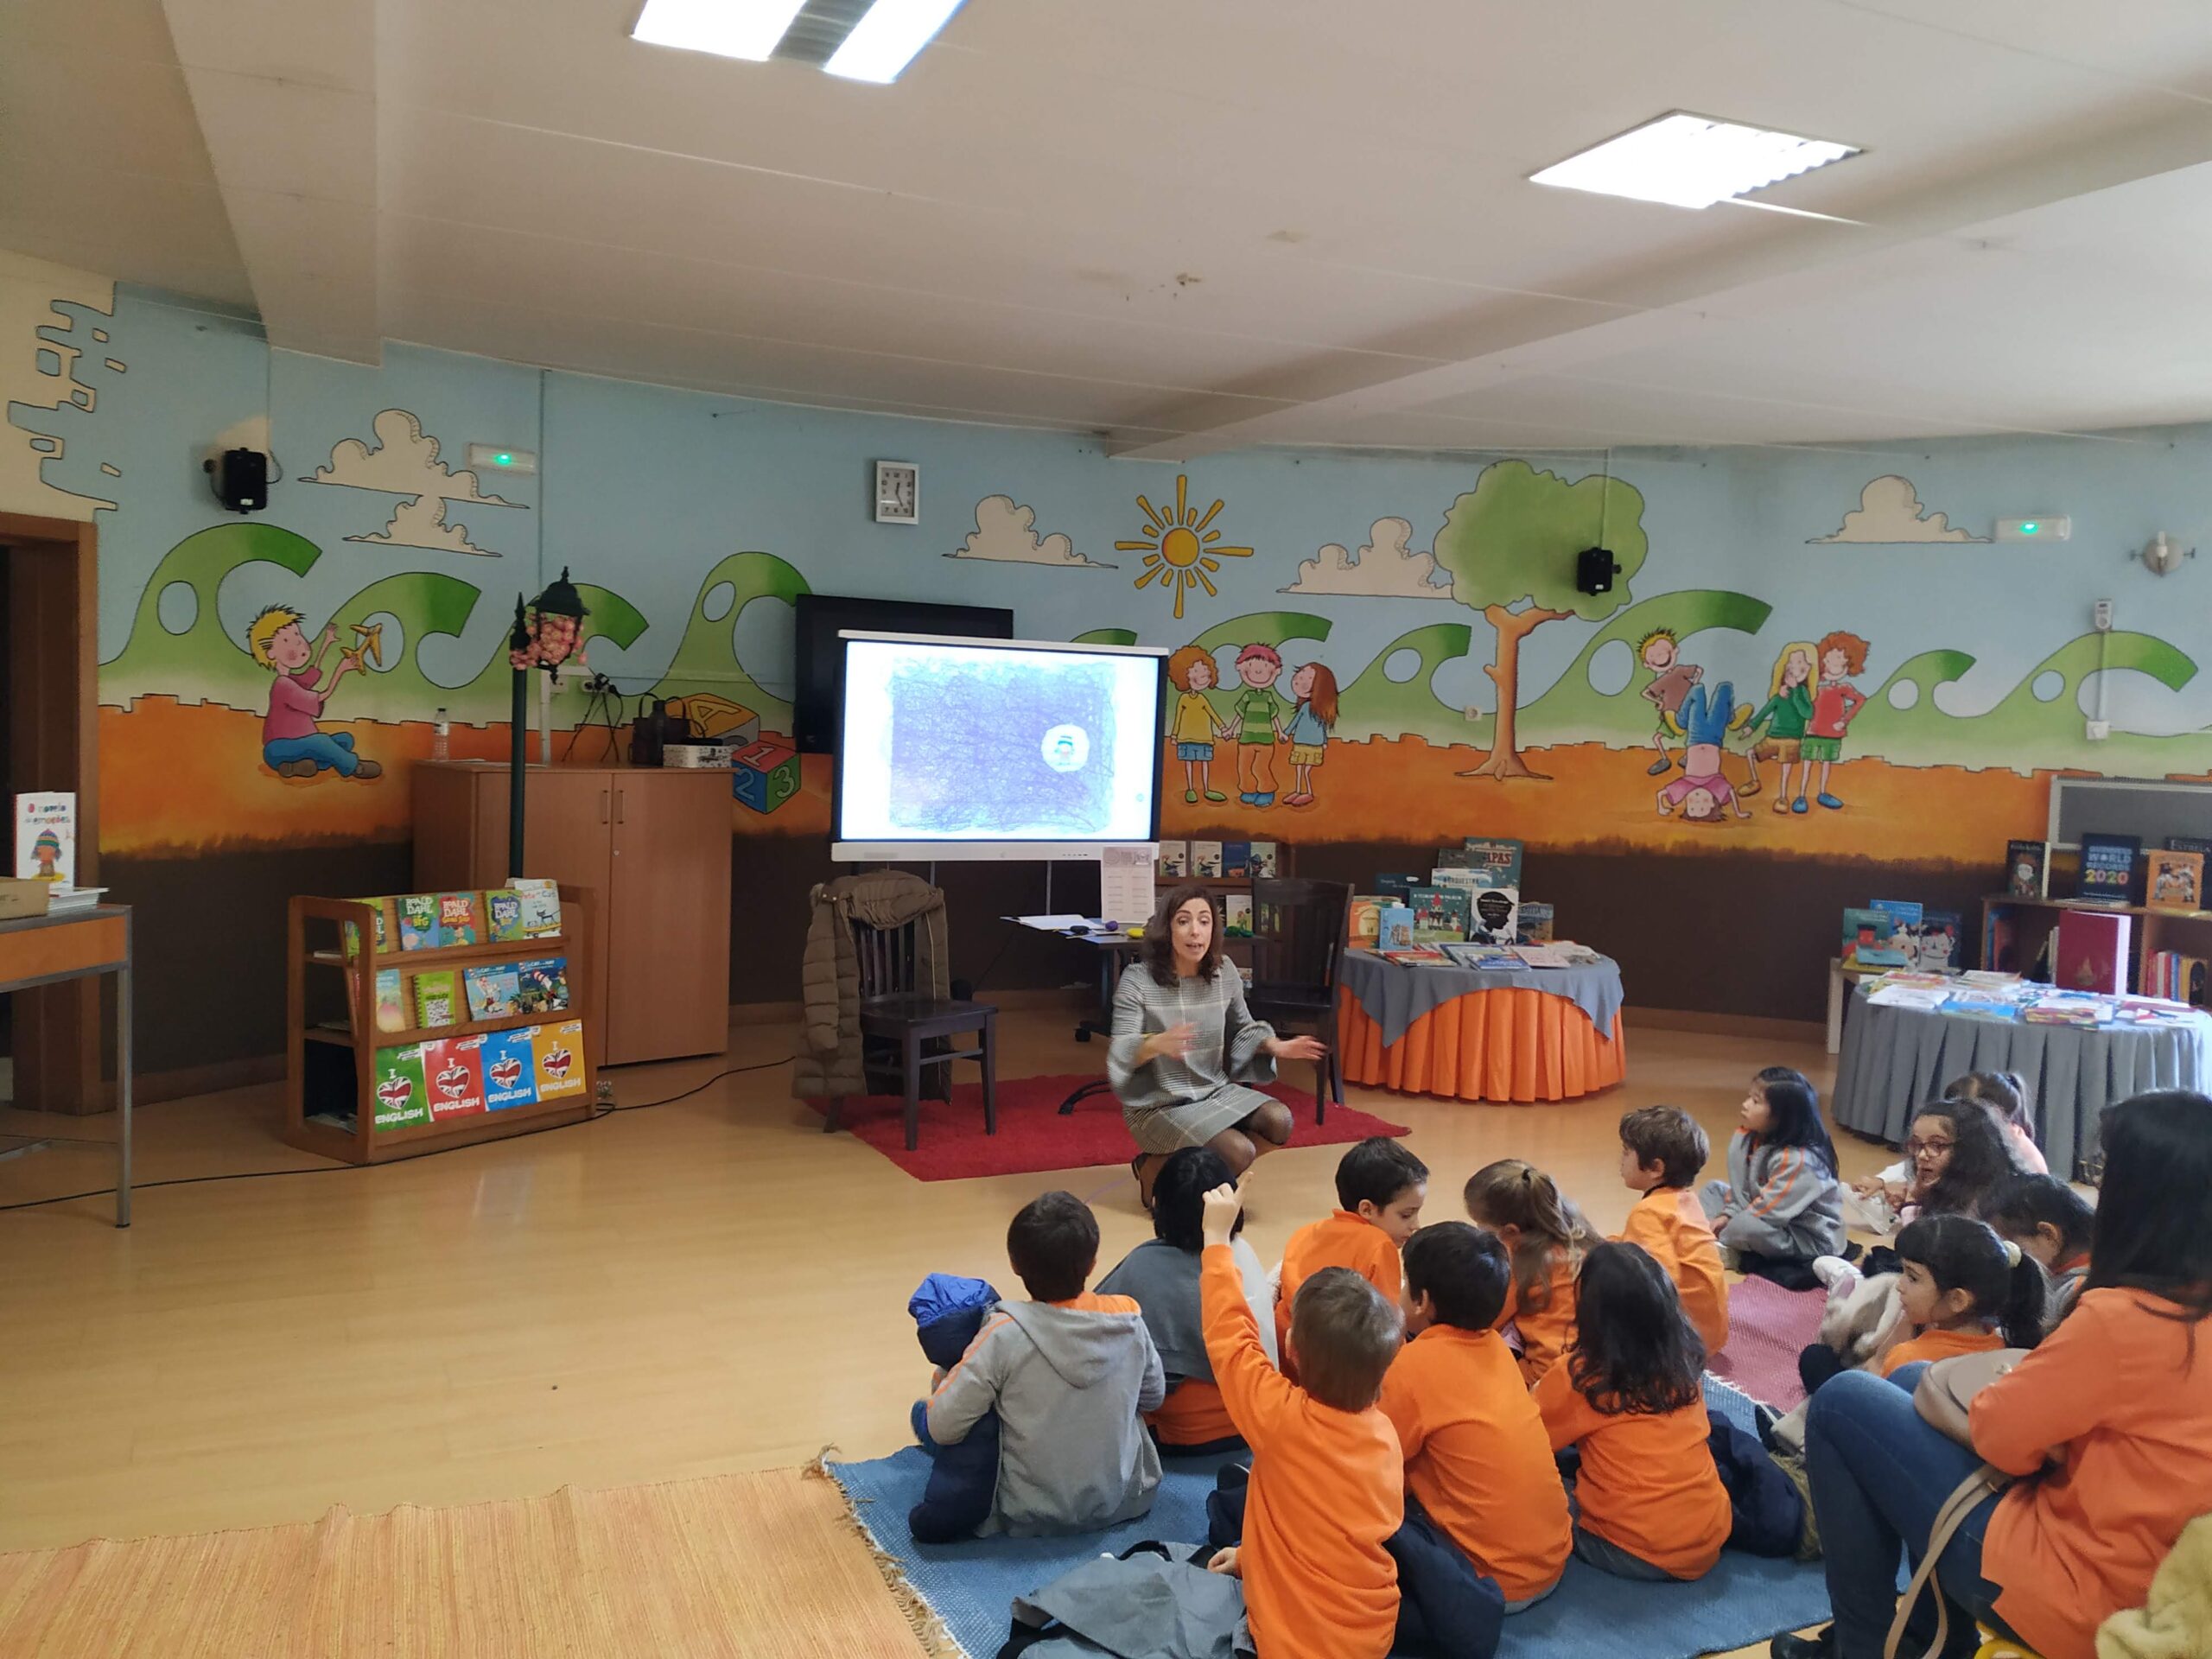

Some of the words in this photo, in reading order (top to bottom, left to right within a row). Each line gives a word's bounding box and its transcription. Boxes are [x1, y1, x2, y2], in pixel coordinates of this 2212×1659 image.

[689, 699, 741, 734] A
[743, 746, 775, 767] 1
[735, 768, 755, 802] 2
[773, 766, 795, 798] 3
[2088, 853, 2132, 863] WORLD
[2084, 869, 2129, 885] 2020
[405, 896, 433, 907] ROALD
[442, 899, 468, 910] ROALD
[493, 900, 518, 910] ROALD
[406, 905, 433, 915] DAHL
[443, 907, 469, 917] DAHL
[495, 909, 518, 918] DAHL
[551, 1040, 559, 1051] I
[499, 1050, 507, 1060] I
[448, 1058, 455, 1068] I
[388, 1069, 397, 1079] I
[540, 1077, 582, 1093] ENGLISH
[487, 1087, 532, 1103] ENGLISH
[433, 1096, 480, 1112] ENGLISH
[375, 1108, 423, 1123] ENGLISH
